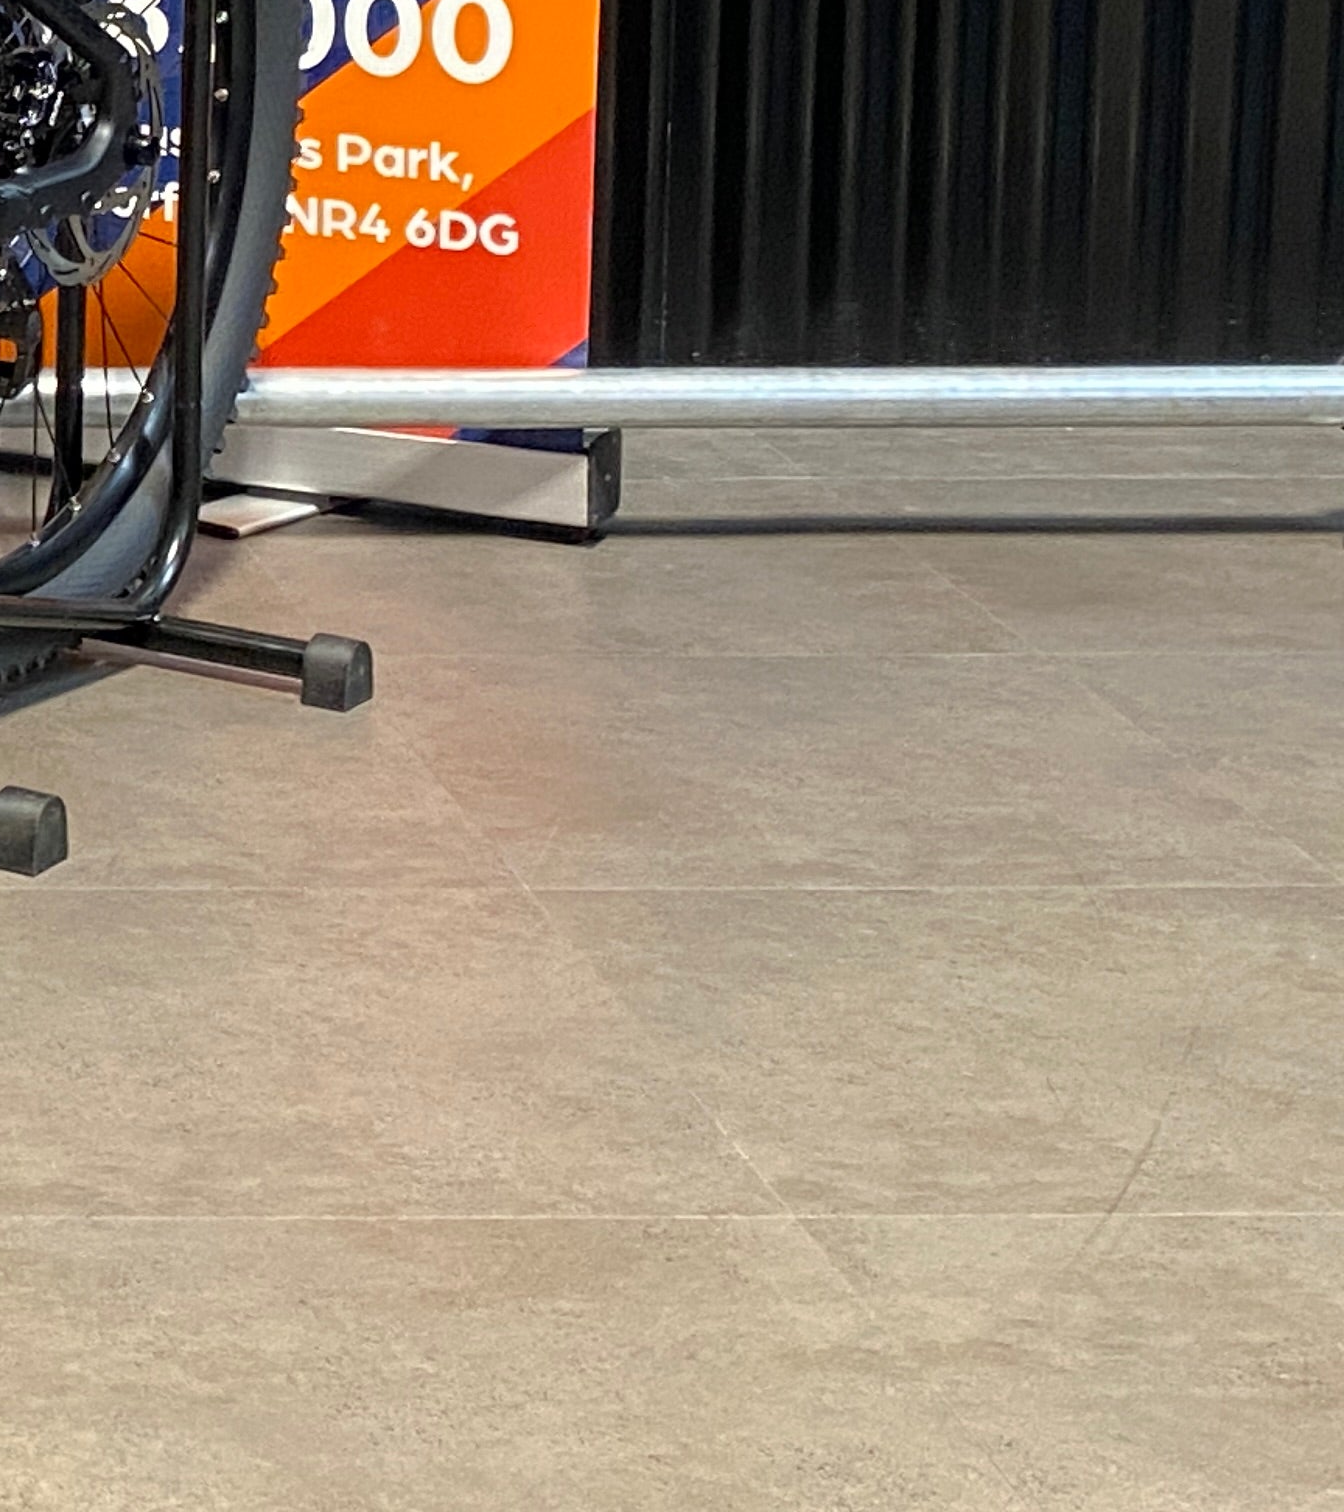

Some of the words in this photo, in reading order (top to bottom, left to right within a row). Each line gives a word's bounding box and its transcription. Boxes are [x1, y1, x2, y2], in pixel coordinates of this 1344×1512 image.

[336, 133, 474, 191] Park,
[284, 194, 390, 243] NR4
[405, 208, 519, 256] 6DG
